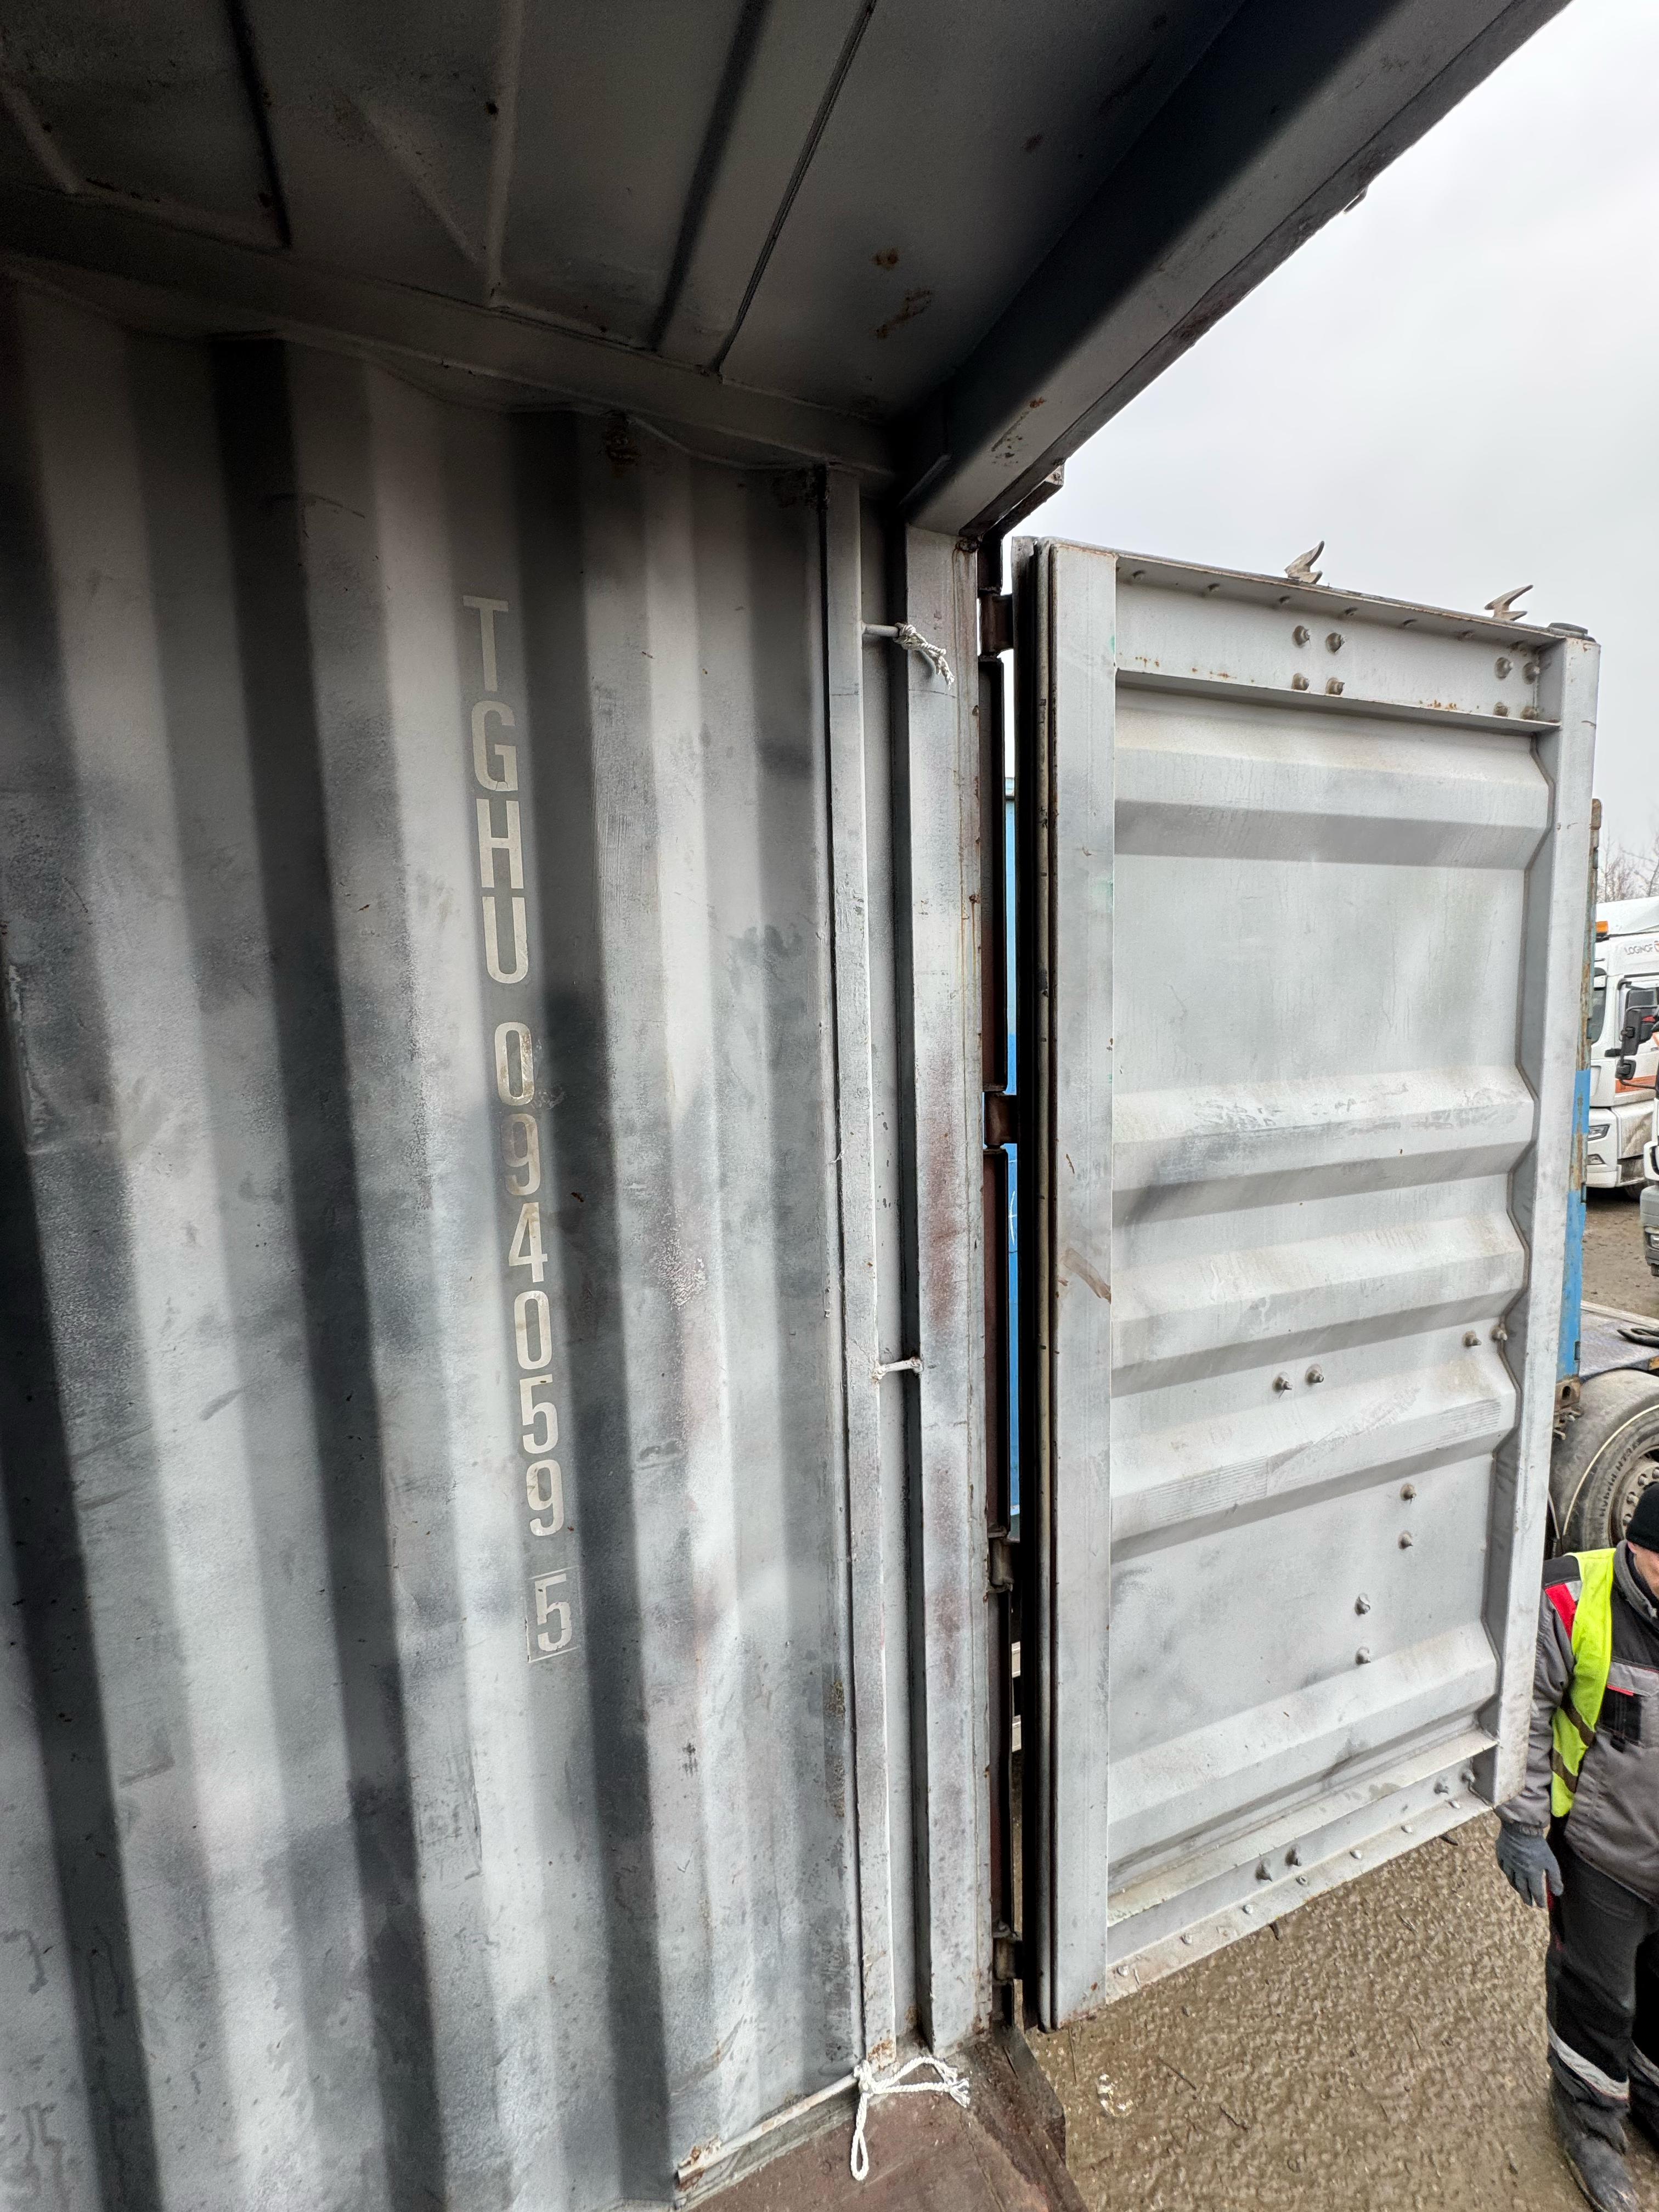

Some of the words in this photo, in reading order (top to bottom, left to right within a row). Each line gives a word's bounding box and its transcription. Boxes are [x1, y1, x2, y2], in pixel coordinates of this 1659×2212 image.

[462, 595, 529, 984] TGHU
[494, 1022, 565, 1536] 094059
[534, 1573, 573, 1652] 5
